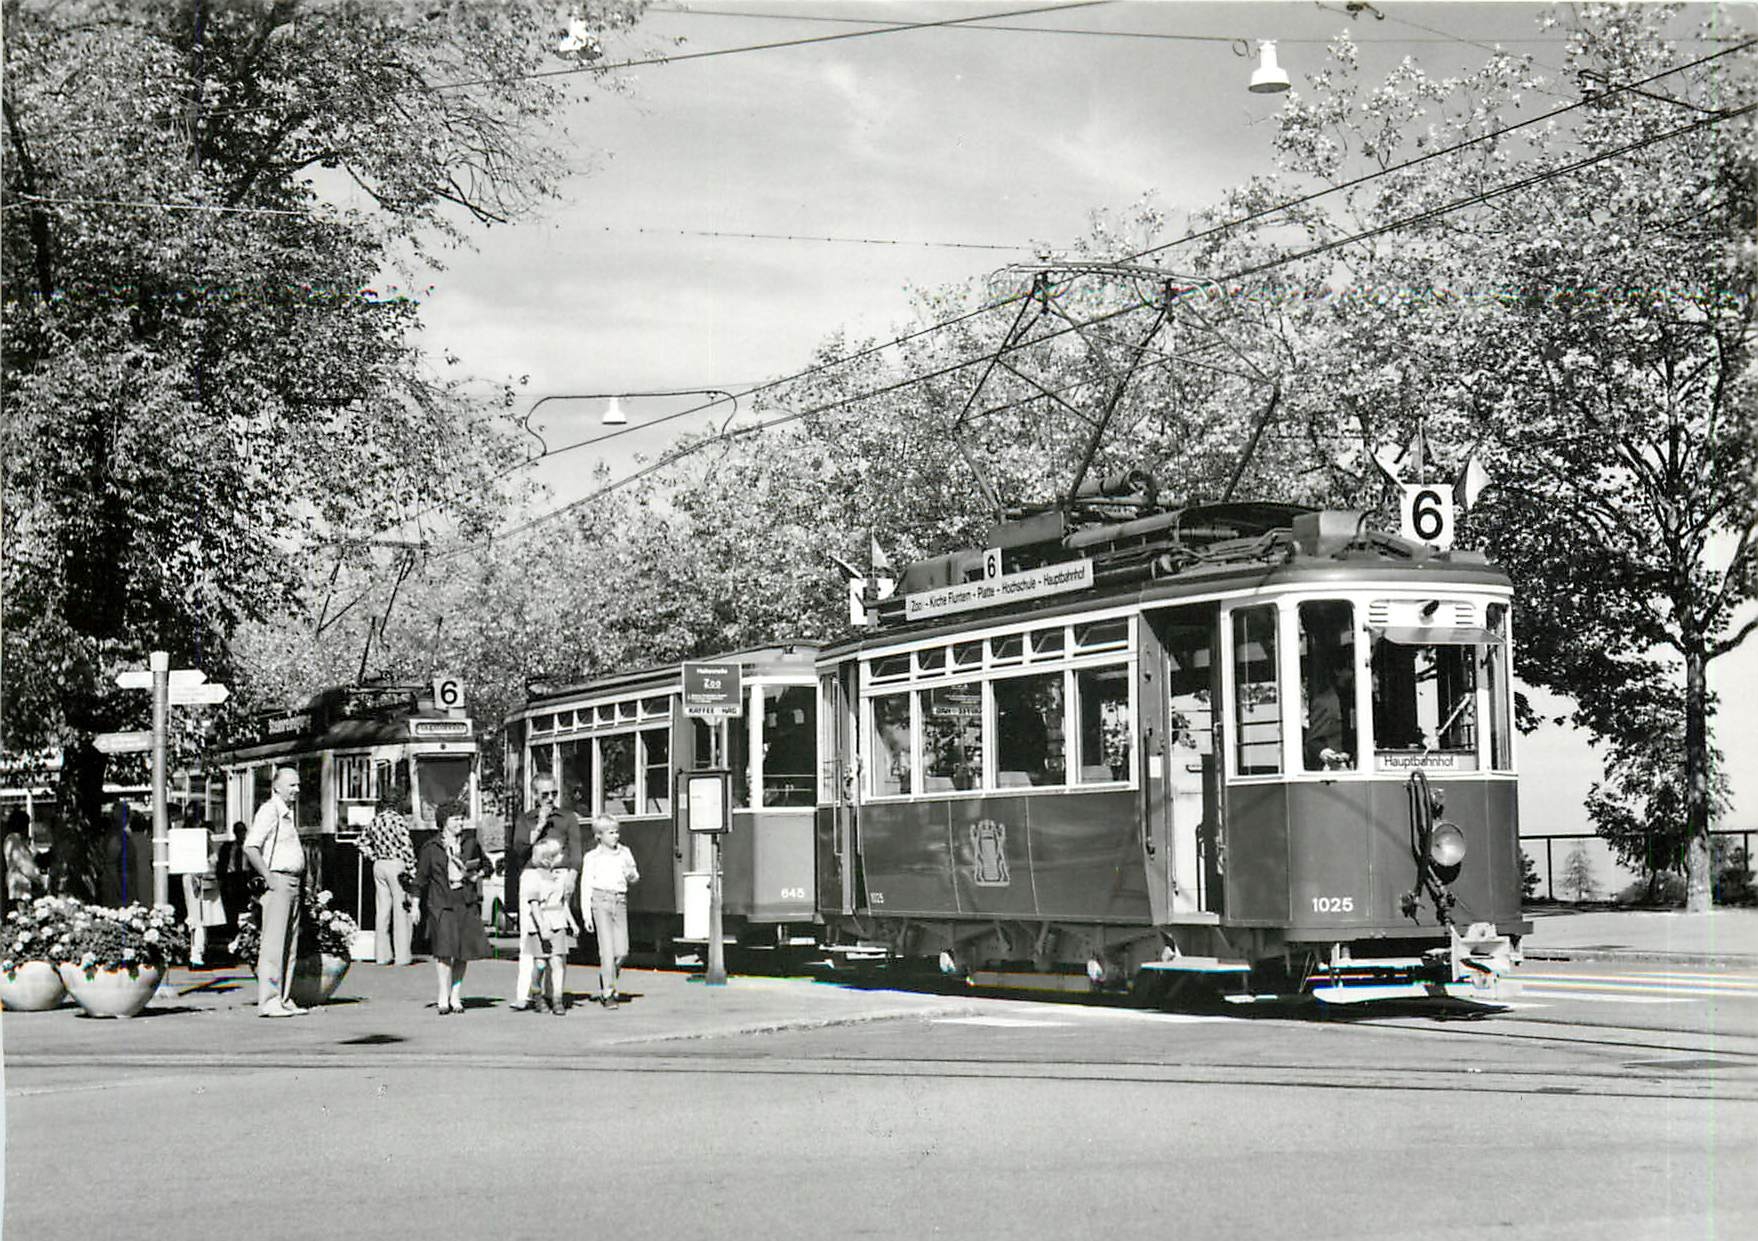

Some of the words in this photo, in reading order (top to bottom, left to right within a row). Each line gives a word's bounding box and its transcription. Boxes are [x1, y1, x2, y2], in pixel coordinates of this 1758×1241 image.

[1412, 490, 1444, 541] 6
[986, 554, 997, 578] 6
[1002, 577, 1036, 594] Hochschule
[1043, 565, 1085, 587] Hauptbahnhof
[440, 680, 458, 705] 6
[703, 678, 722, 689] Zoo
[1384, 754, 1455, 770] Hauptbahnhof
[1312, 897, 1354, 912] 1025
